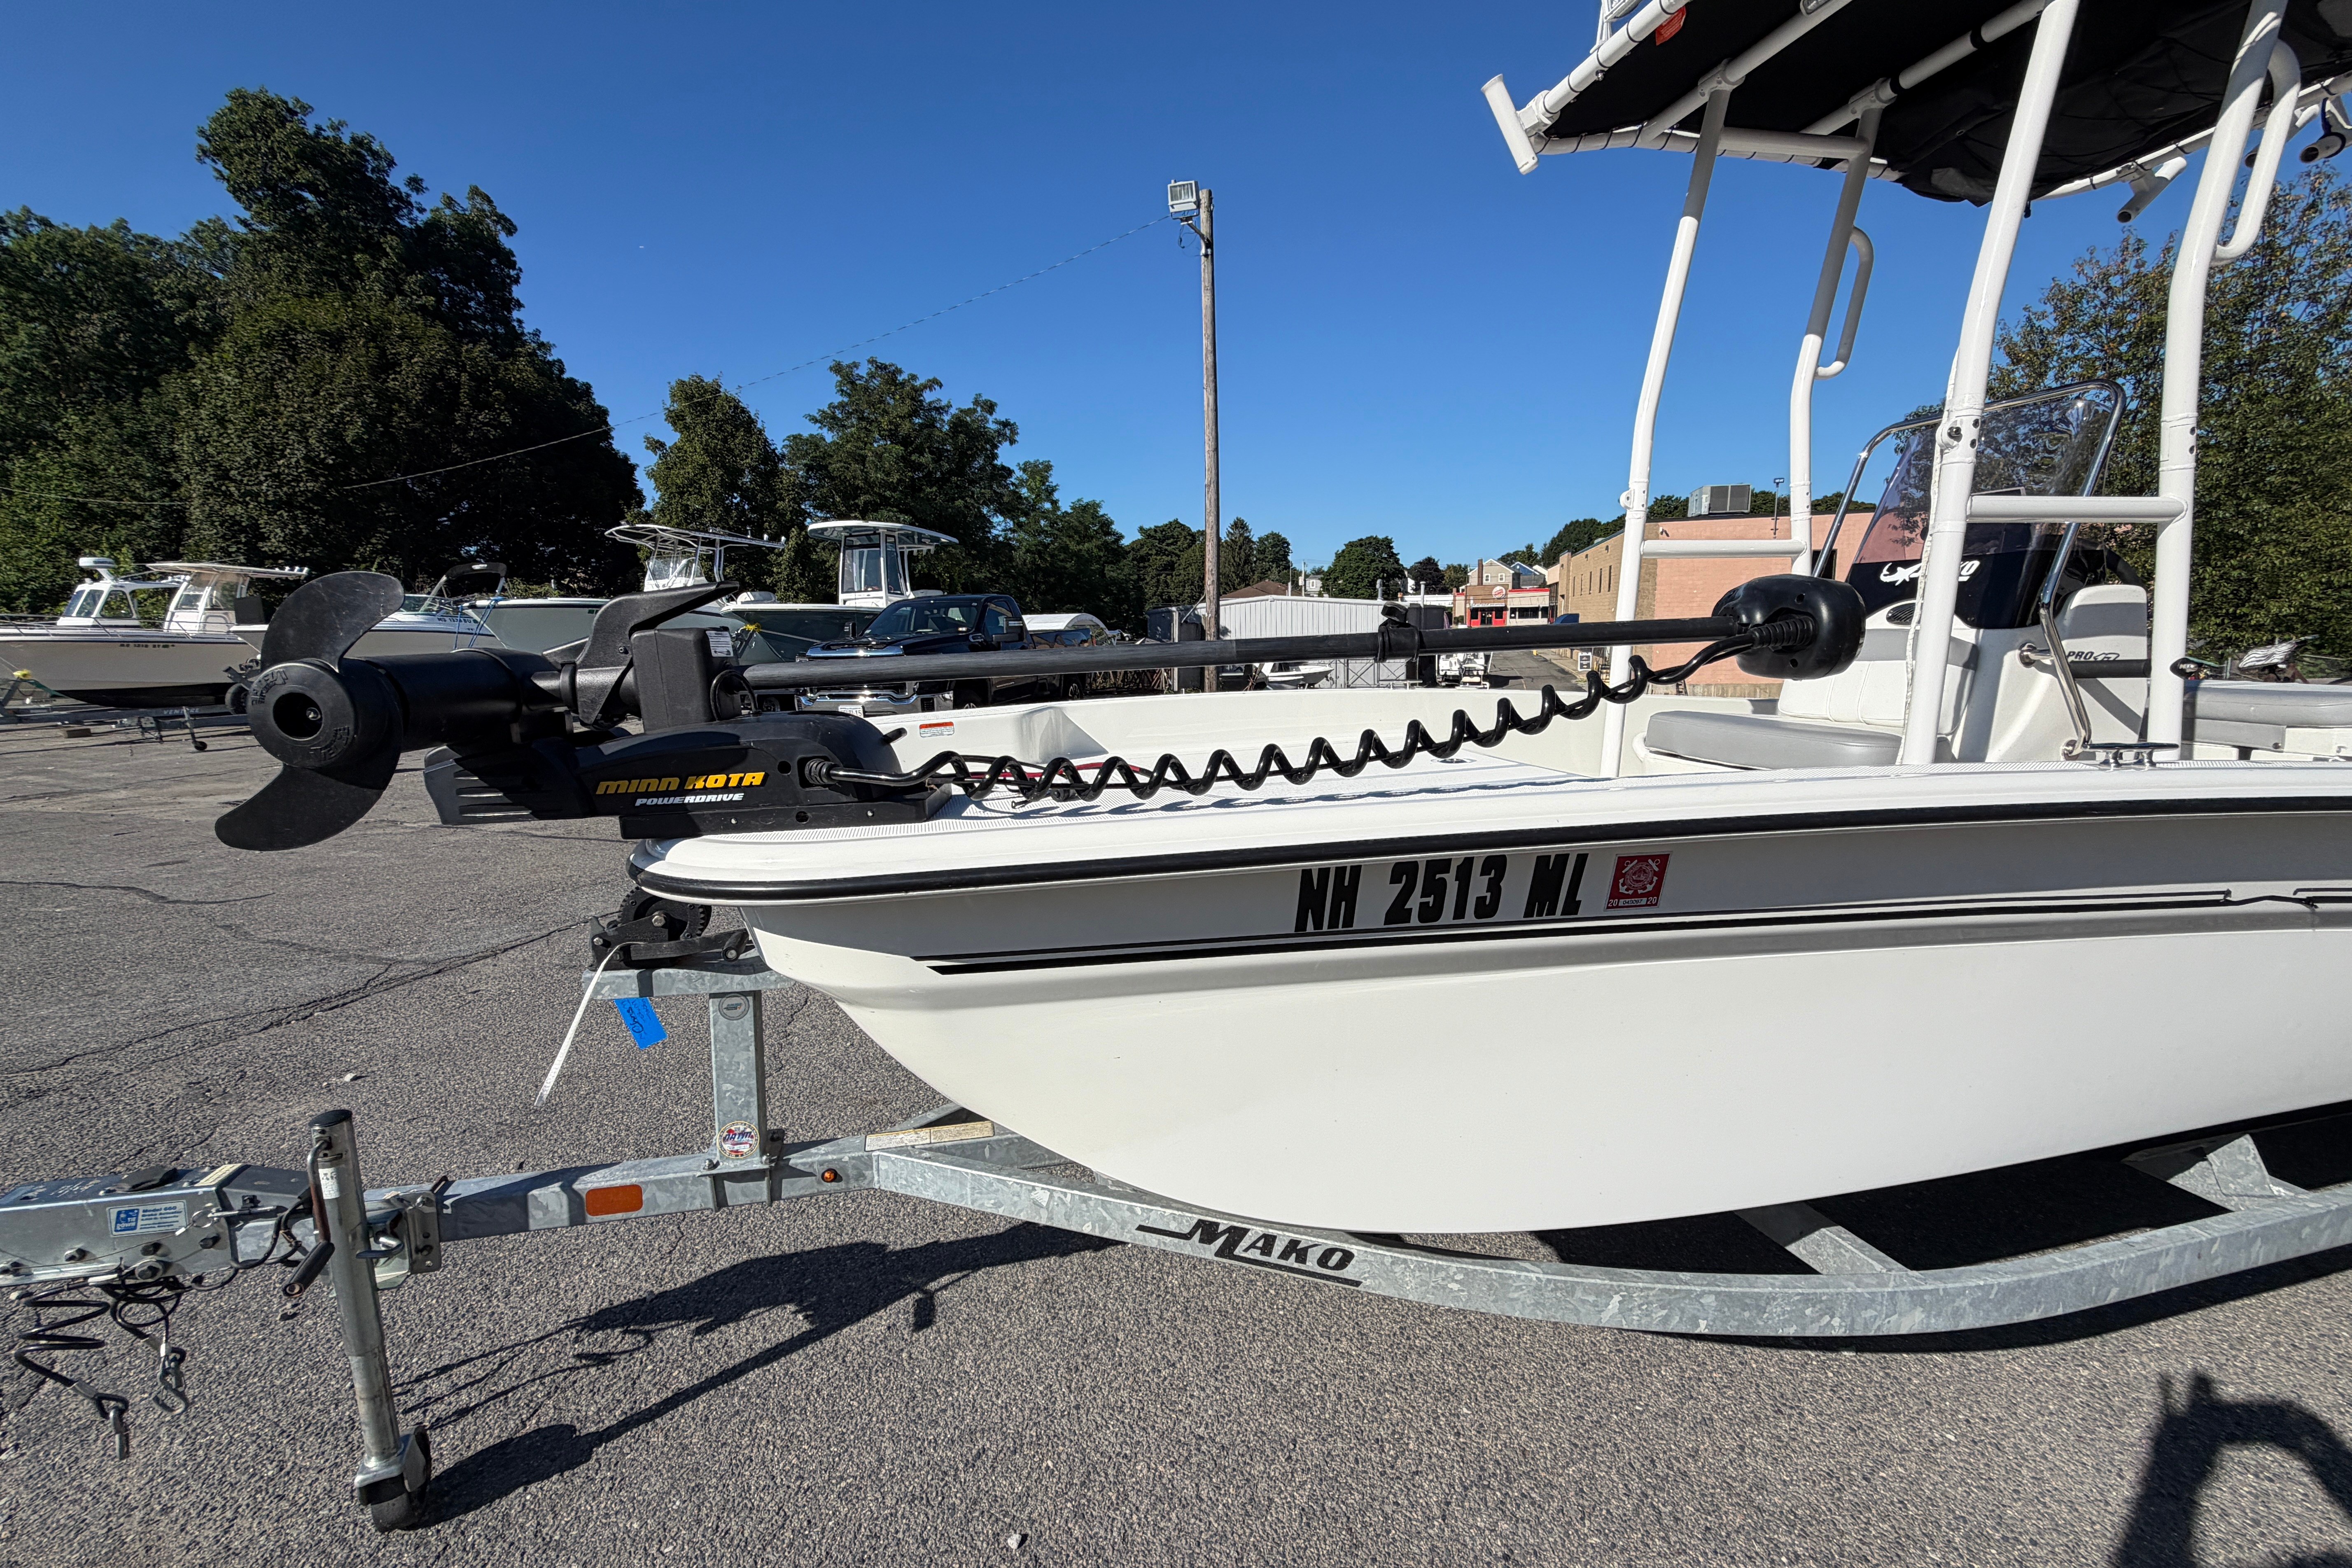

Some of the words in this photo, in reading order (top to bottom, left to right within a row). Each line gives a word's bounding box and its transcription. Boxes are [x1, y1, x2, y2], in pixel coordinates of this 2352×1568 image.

[2066, 651, 2095, 660] PRO
[596, 777, 680, 794] MINN
[684, 772, 766, 789] KOTA
[635, 793, 744, 806] POWERDRIVE
[1294, 865, 1362, 933] NH
[1383, 854, 1507, 926] 2513
[1523, 853, 1589, 918] ML
[1187, 1218, 1356, 1272] MAKO
